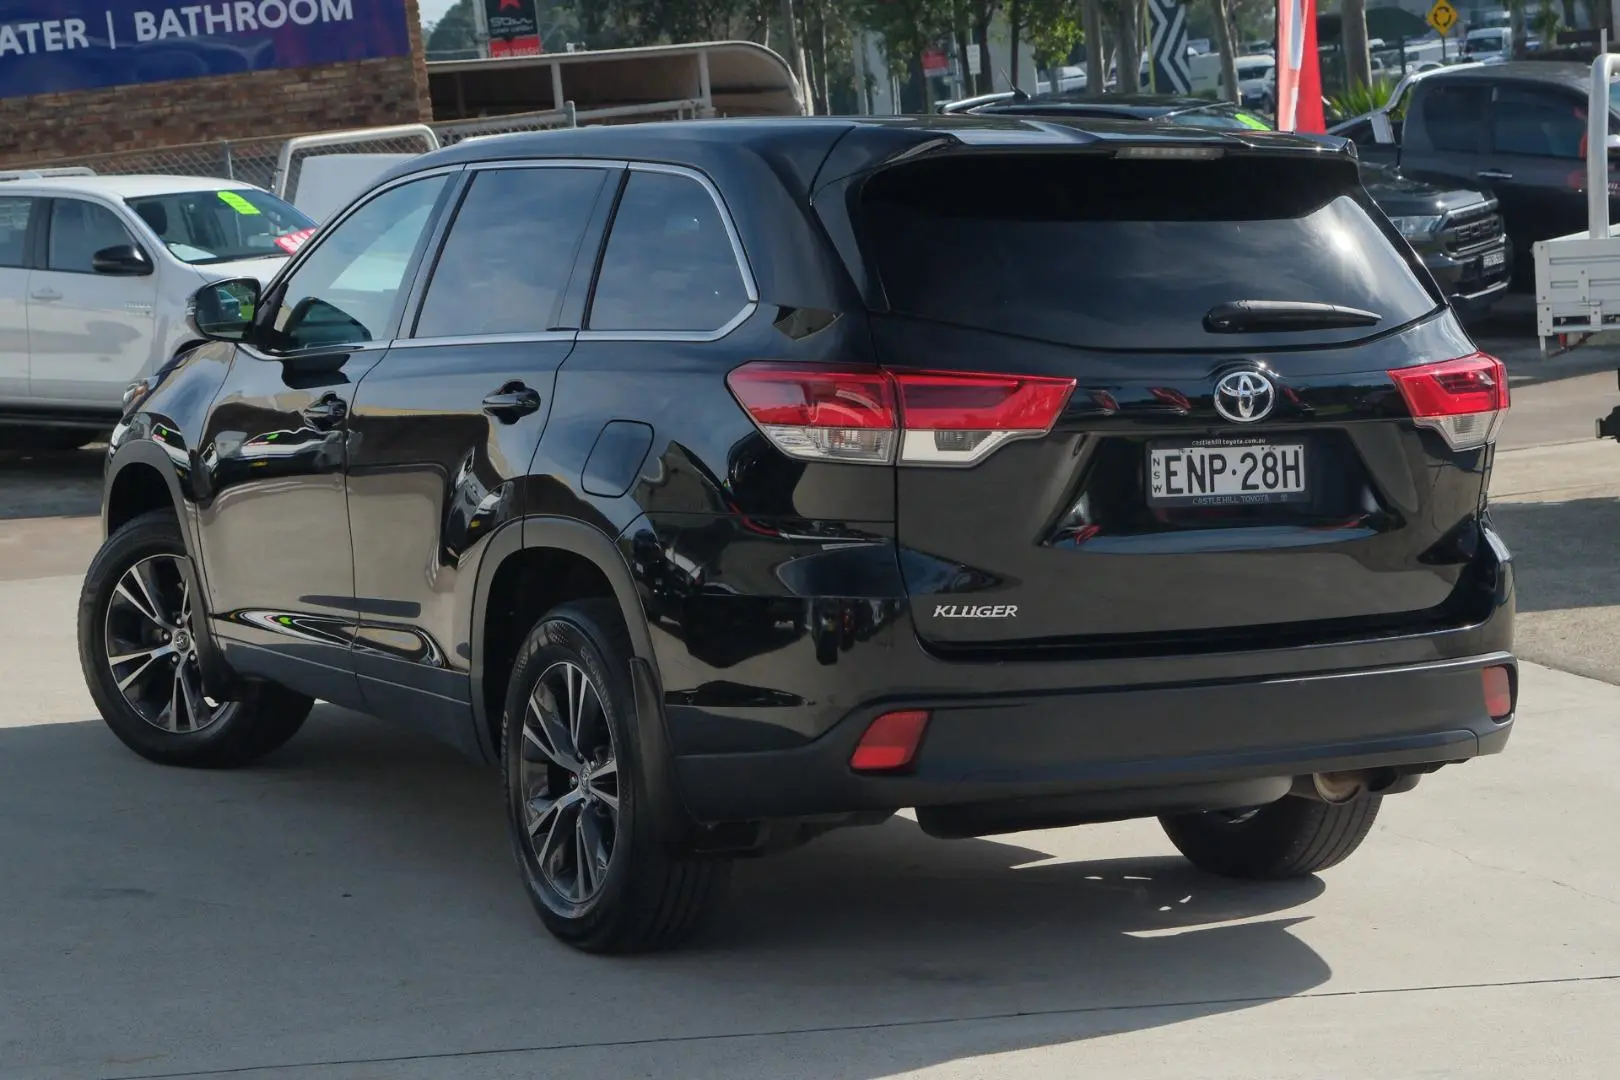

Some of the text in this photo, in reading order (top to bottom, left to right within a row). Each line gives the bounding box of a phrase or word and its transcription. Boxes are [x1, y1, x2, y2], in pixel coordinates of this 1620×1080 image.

[0, 0, 354, 56] ATER BATHROOM
[1240, 494, 1269, 504] TOYOTA
[933, 604, 1018, 618] KLUGER
